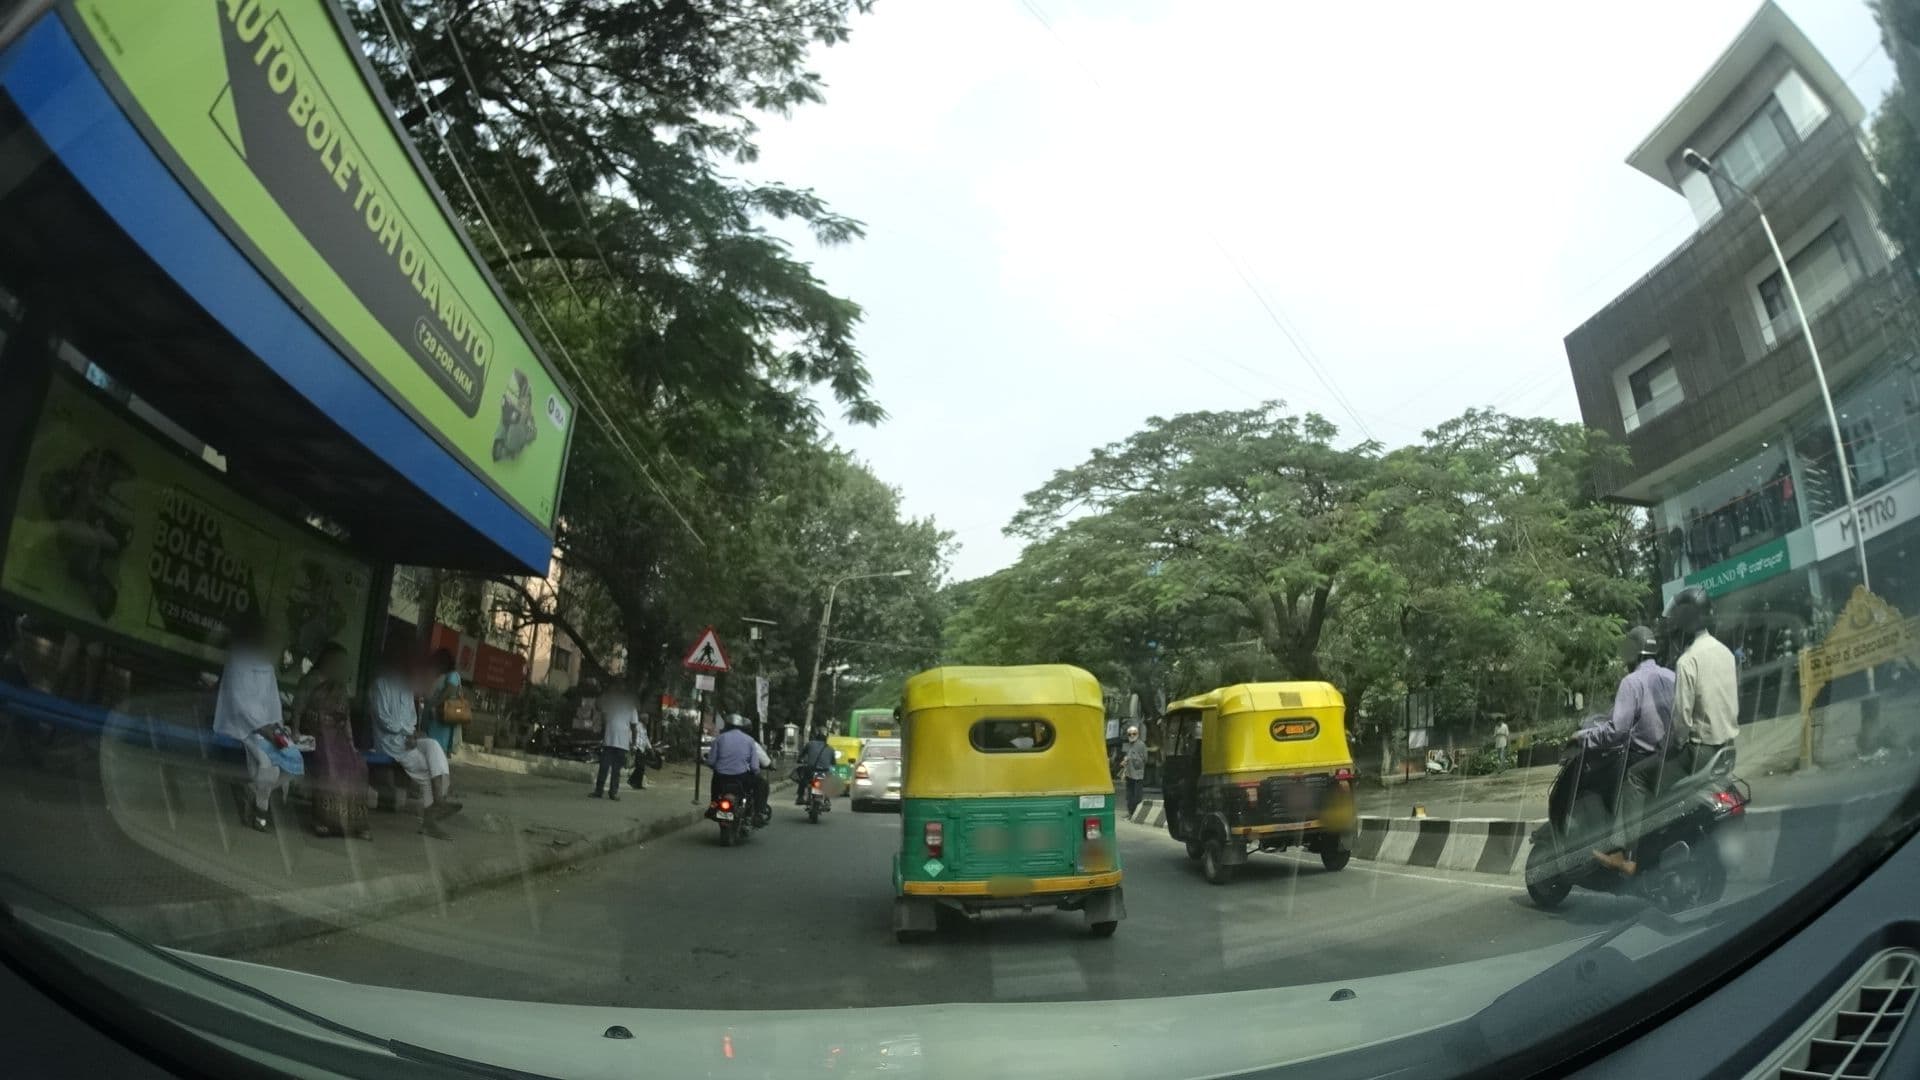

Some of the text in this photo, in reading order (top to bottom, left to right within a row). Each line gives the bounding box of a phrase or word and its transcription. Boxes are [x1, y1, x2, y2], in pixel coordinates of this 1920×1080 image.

[288, 90, 358, 191] BOLE
[353, 168, 403, 255] TOH
[399, 243, 440, 312] OLA
[439, 302, 488, 367] AUTO
[436, 344, 454, 375] FOR
[162, 488, 218, 538] AUTO
[1840, 496, 1897, 541] METRO
[153, 520, 250, 585] BOLE TOH
[150, 551, 250, 613] OLA AUTO
